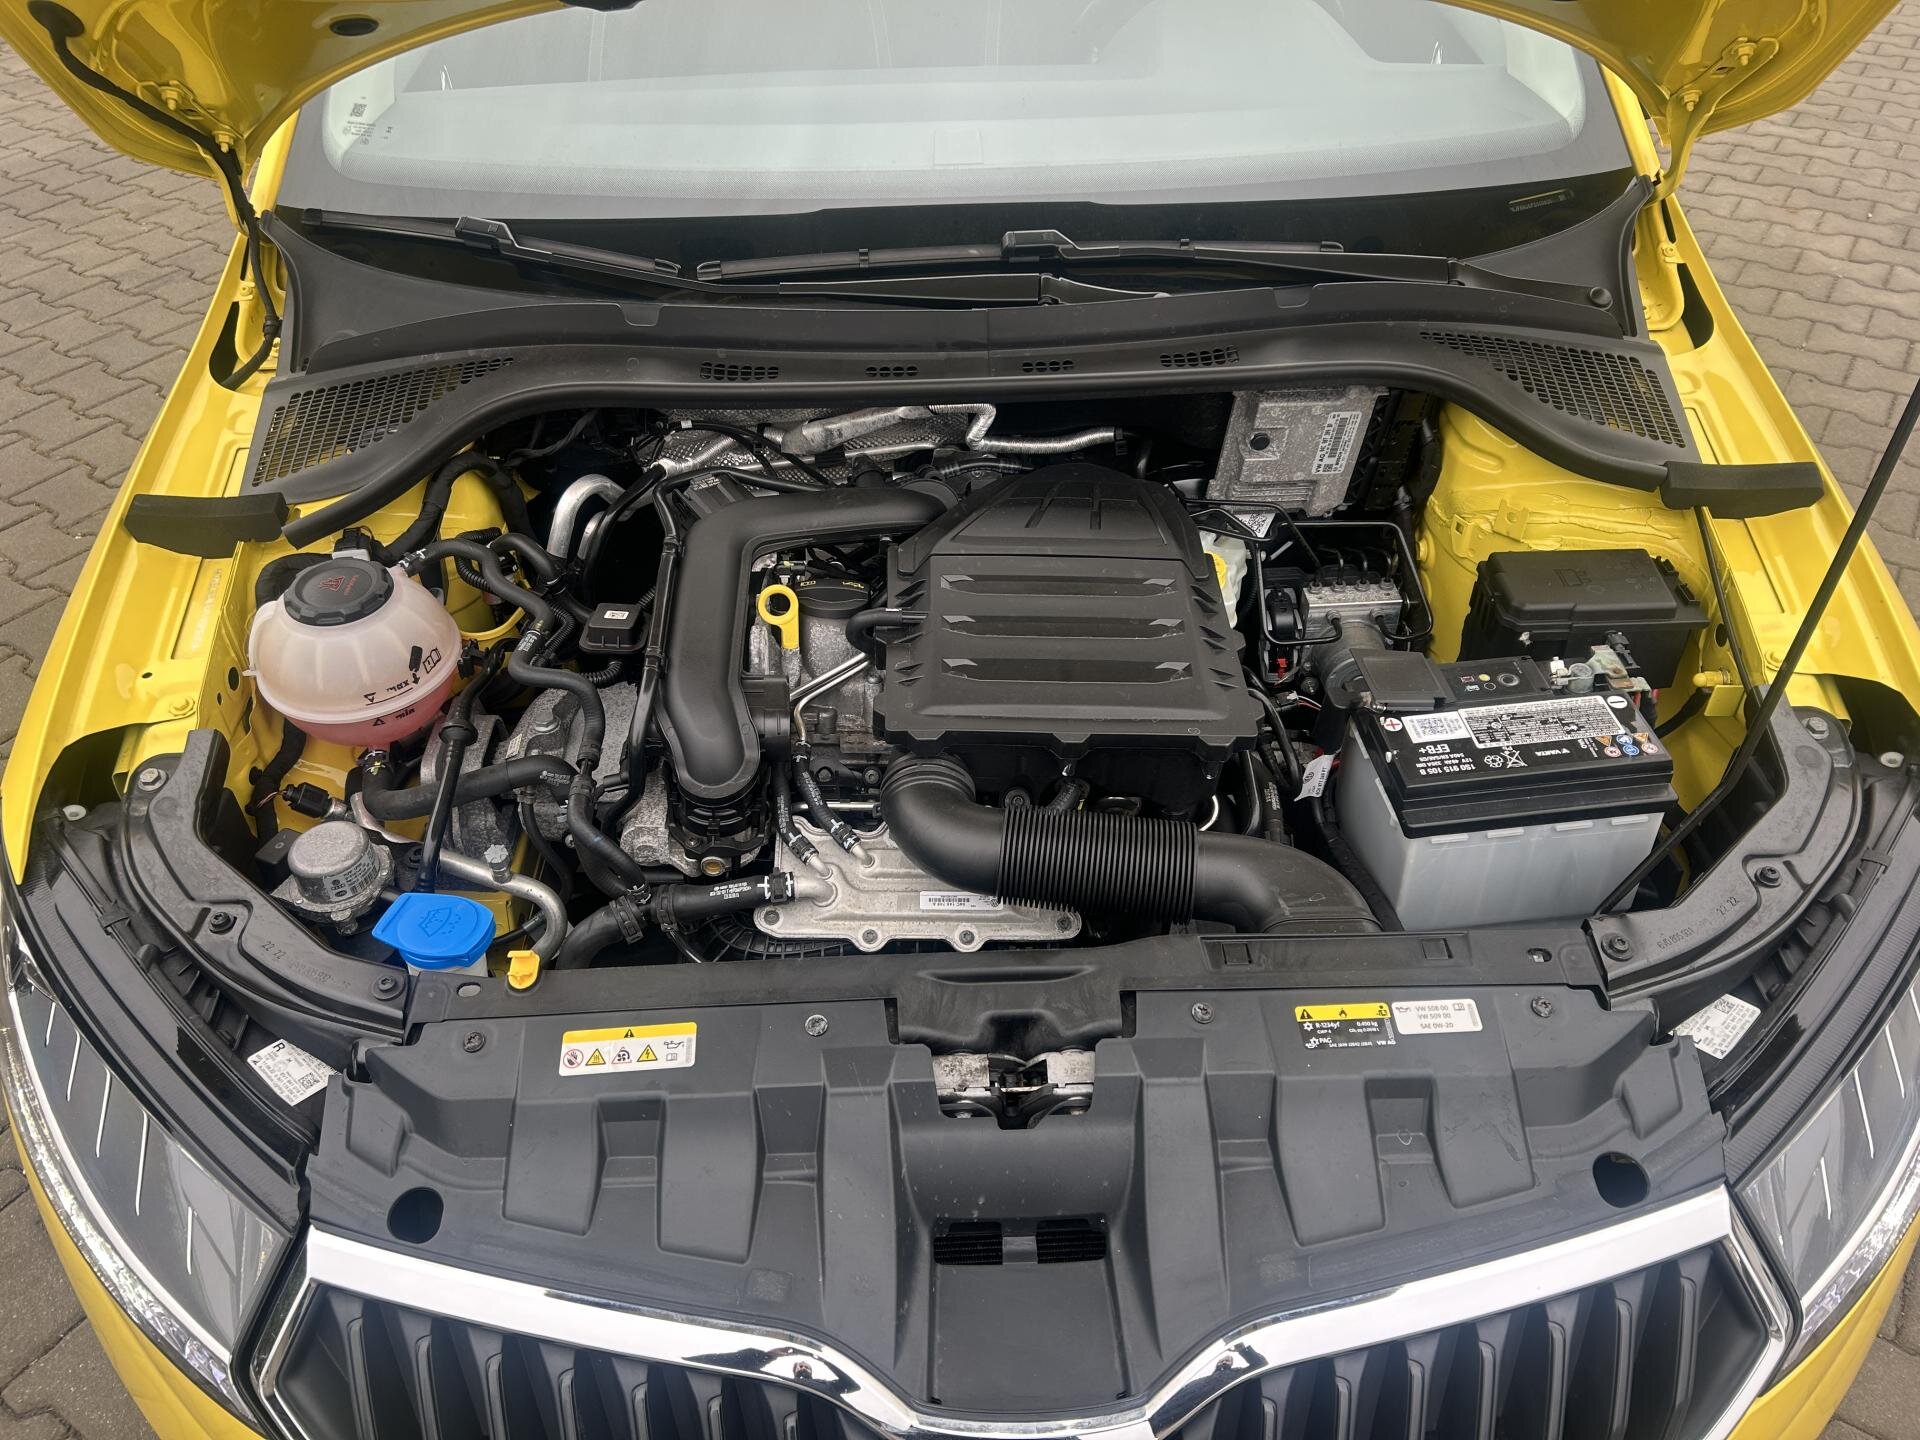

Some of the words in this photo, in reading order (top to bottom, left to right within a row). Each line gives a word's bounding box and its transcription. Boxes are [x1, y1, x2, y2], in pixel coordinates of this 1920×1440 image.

[386, 680, 409, 691] max
[395, 708, 415, 718] min
[1419, 743, 1450, 754] EFB+
[272, 1042, 285, 1052] R
